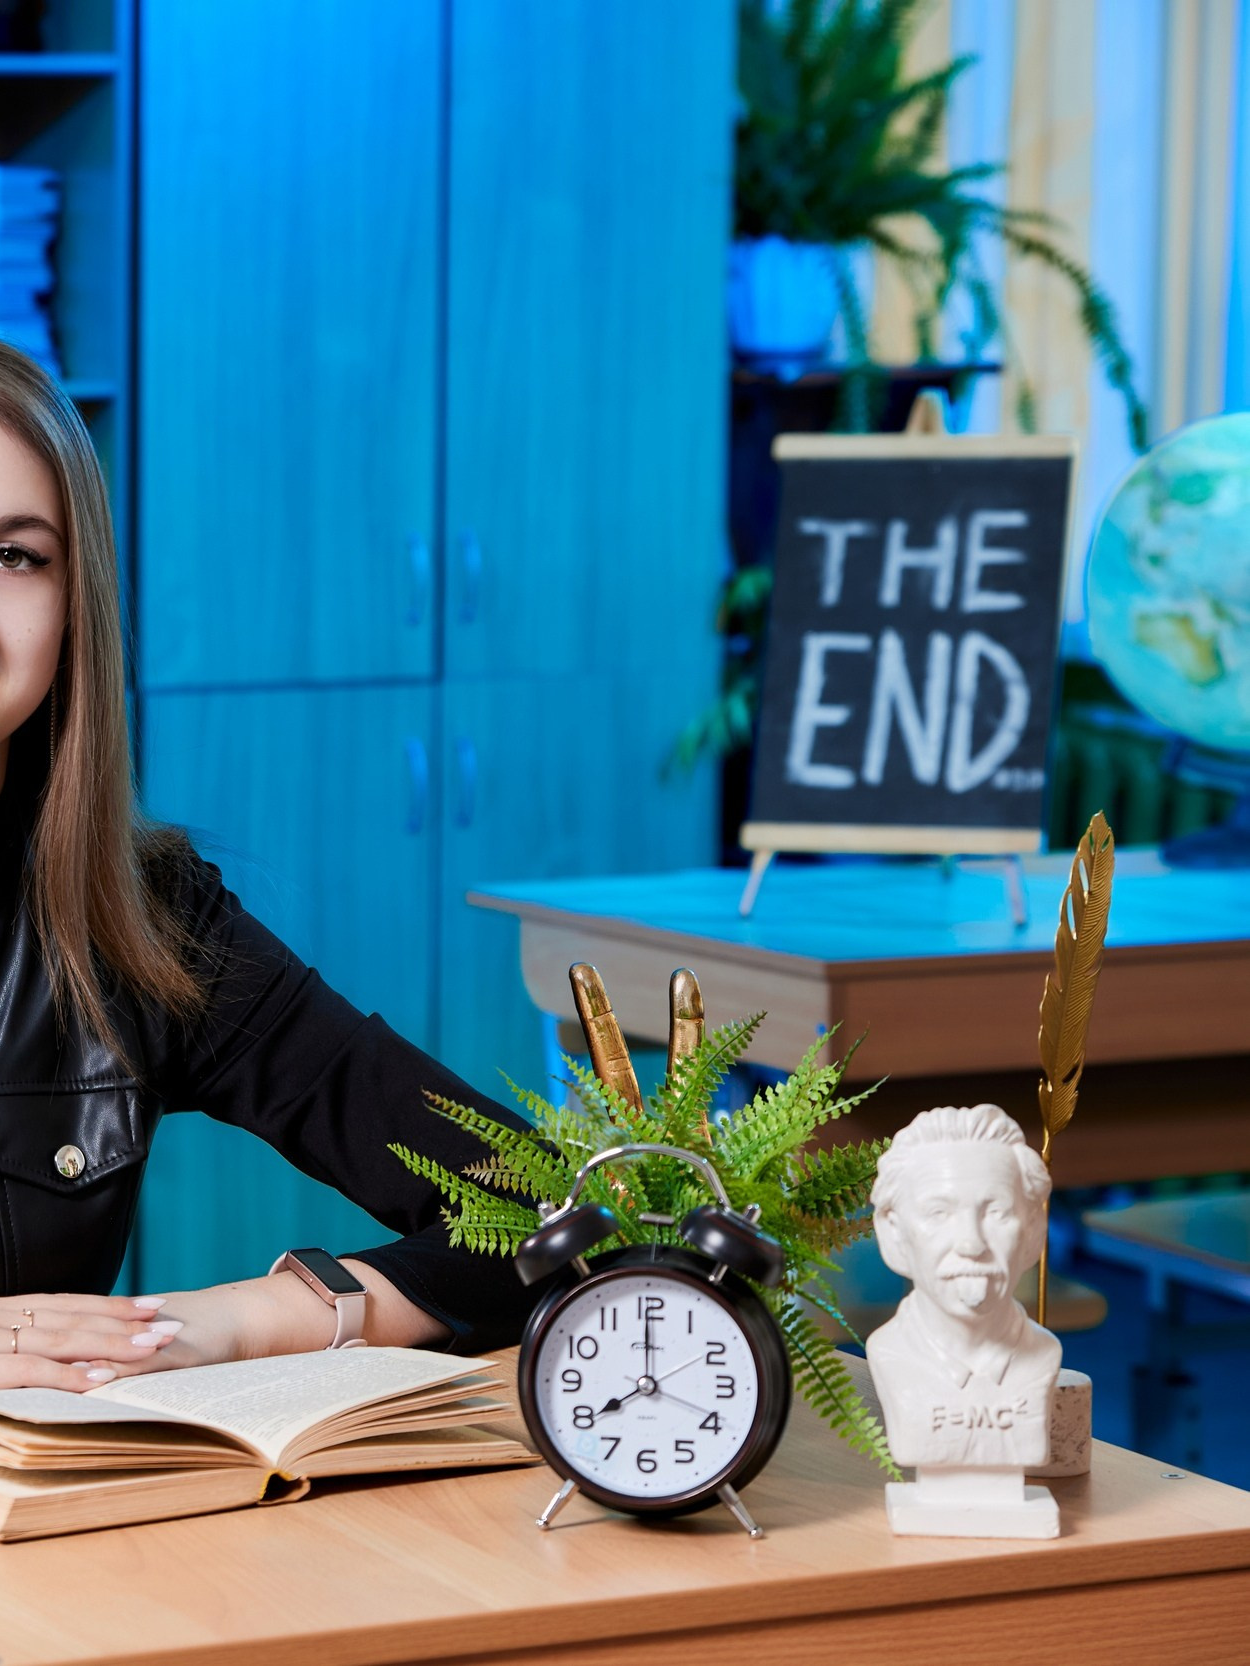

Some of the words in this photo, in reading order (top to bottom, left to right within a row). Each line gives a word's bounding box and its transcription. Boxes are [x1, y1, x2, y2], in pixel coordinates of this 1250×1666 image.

[797, 508, 1029, 614] THE
[600, 1306, 618, 1332] 11
[637, 1296, 665, 1321] 12
[687, 1310, 693, 1334] 1
[569, 1335, 598, 1360] 10
[705, 1341, 726, 1366] 2
[561, 1369, 582, 1393] 9
[715, 1375, 736, 1399] 3
[572, 1405, 595, 1430] 8
[699, 1411, 722, 1436] 4
[600, 1436, 622, 1461] 7
[674, 1439, 696, 1464] 5
[636, 1449, 658, 1474] 6
